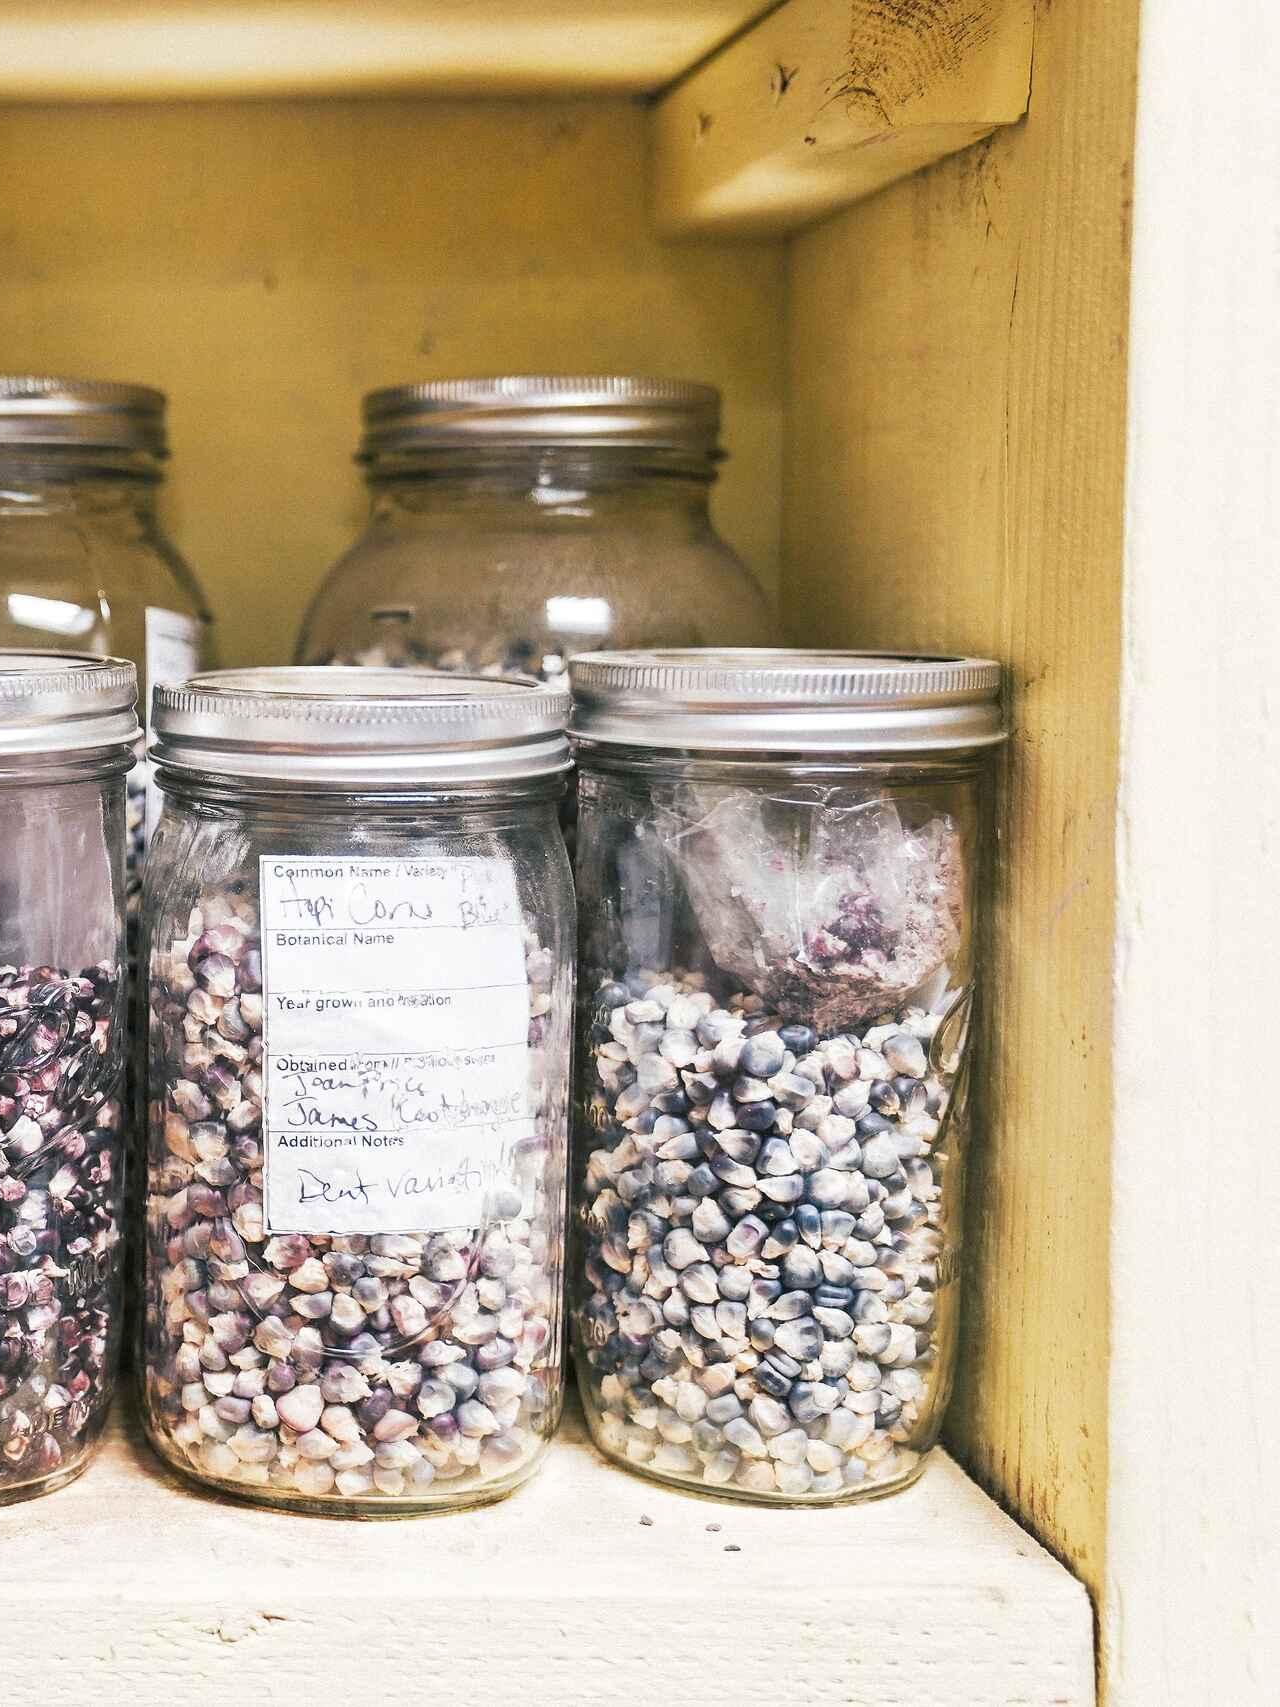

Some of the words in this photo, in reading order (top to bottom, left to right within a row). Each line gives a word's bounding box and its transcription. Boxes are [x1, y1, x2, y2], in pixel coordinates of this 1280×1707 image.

[273, 865, 343, 879] Common
[350, 865, 391, 878] Name
[276, 932, 347, 946] Botanical
[353, 932, 395, 945] Name
[277, 997, 310, 1010] Year
[316, 997, 363, 1012] grown
[277, 1058, 347, 1072] Obtained
[277, 1135, 356, 1149] Additional
[362, 1135, 405, 1148] Notes
